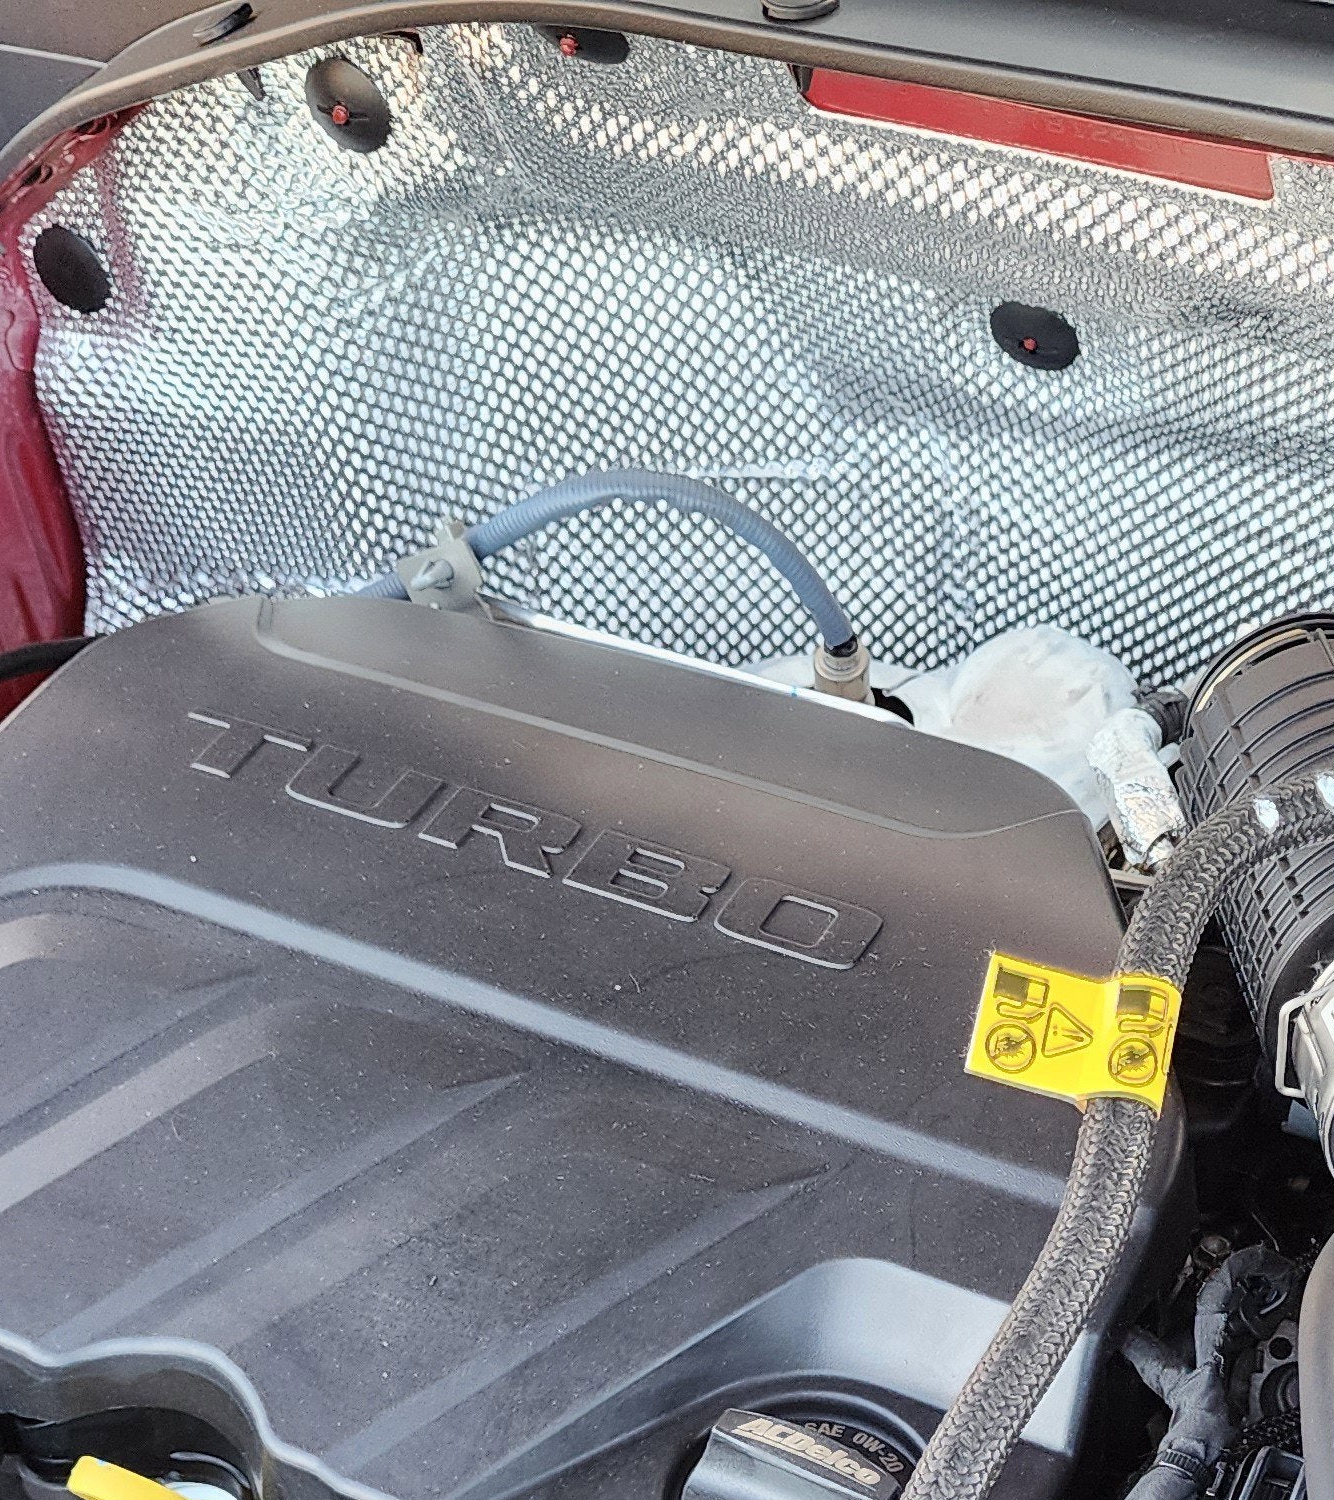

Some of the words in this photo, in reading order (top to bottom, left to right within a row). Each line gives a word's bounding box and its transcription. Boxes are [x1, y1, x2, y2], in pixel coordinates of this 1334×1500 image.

[187, 712, 884, 971] TURBO
[734, 1417, 881, 1487] ACDelco
[804, 1422, 846, 1438] SAE
[852, 1431, 905, 1474] 0W-20
